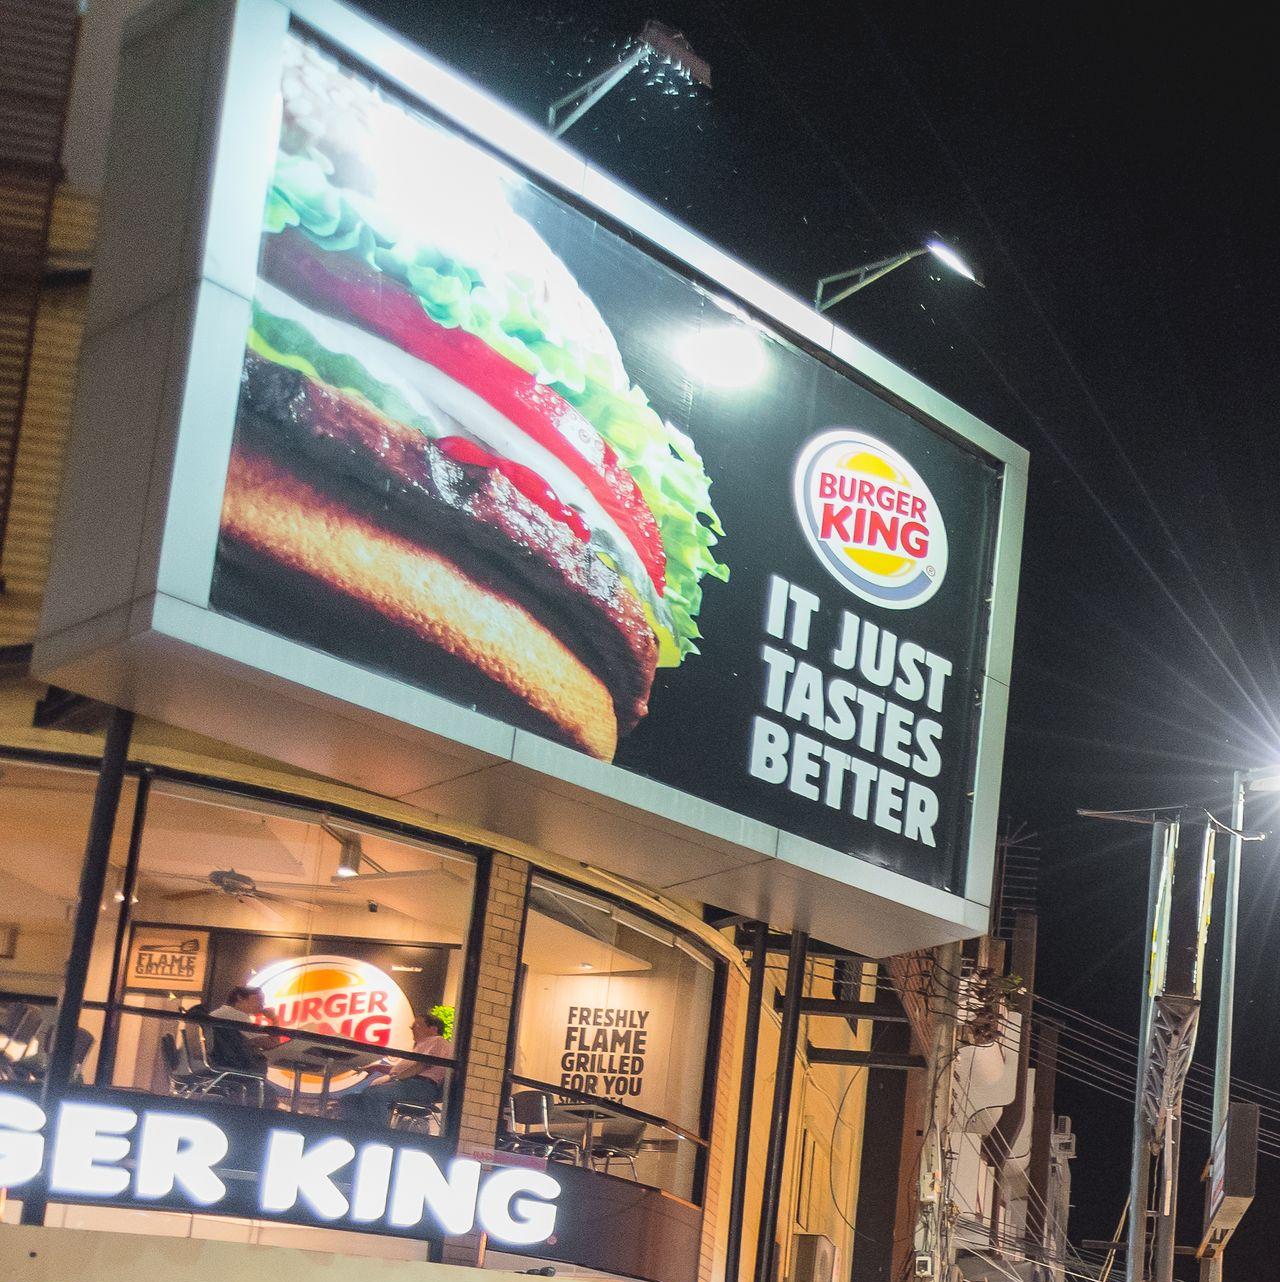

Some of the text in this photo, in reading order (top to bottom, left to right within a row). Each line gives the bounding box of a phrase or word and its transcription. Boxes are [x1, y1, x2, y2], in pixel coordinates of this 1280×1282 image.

[819, 472, 928, 523] BURGER
[820, 503, 930, 559] KING
[767, 575, 953, 713] IT JUST
[762, 645, 943, 778] TASTES
[749, 715, 940, 848] BETTER
[137, 952, 196, 968] FLAME
[565, 1026, 647, 1054] FLAME
[567, 1006, 650, 1029] FRESHLY
[560, 1073, 642, 1096] FOR YOU
[561, 1052, 644, 1075] GRILLED
[259, 1130, 562, 1245] KING
